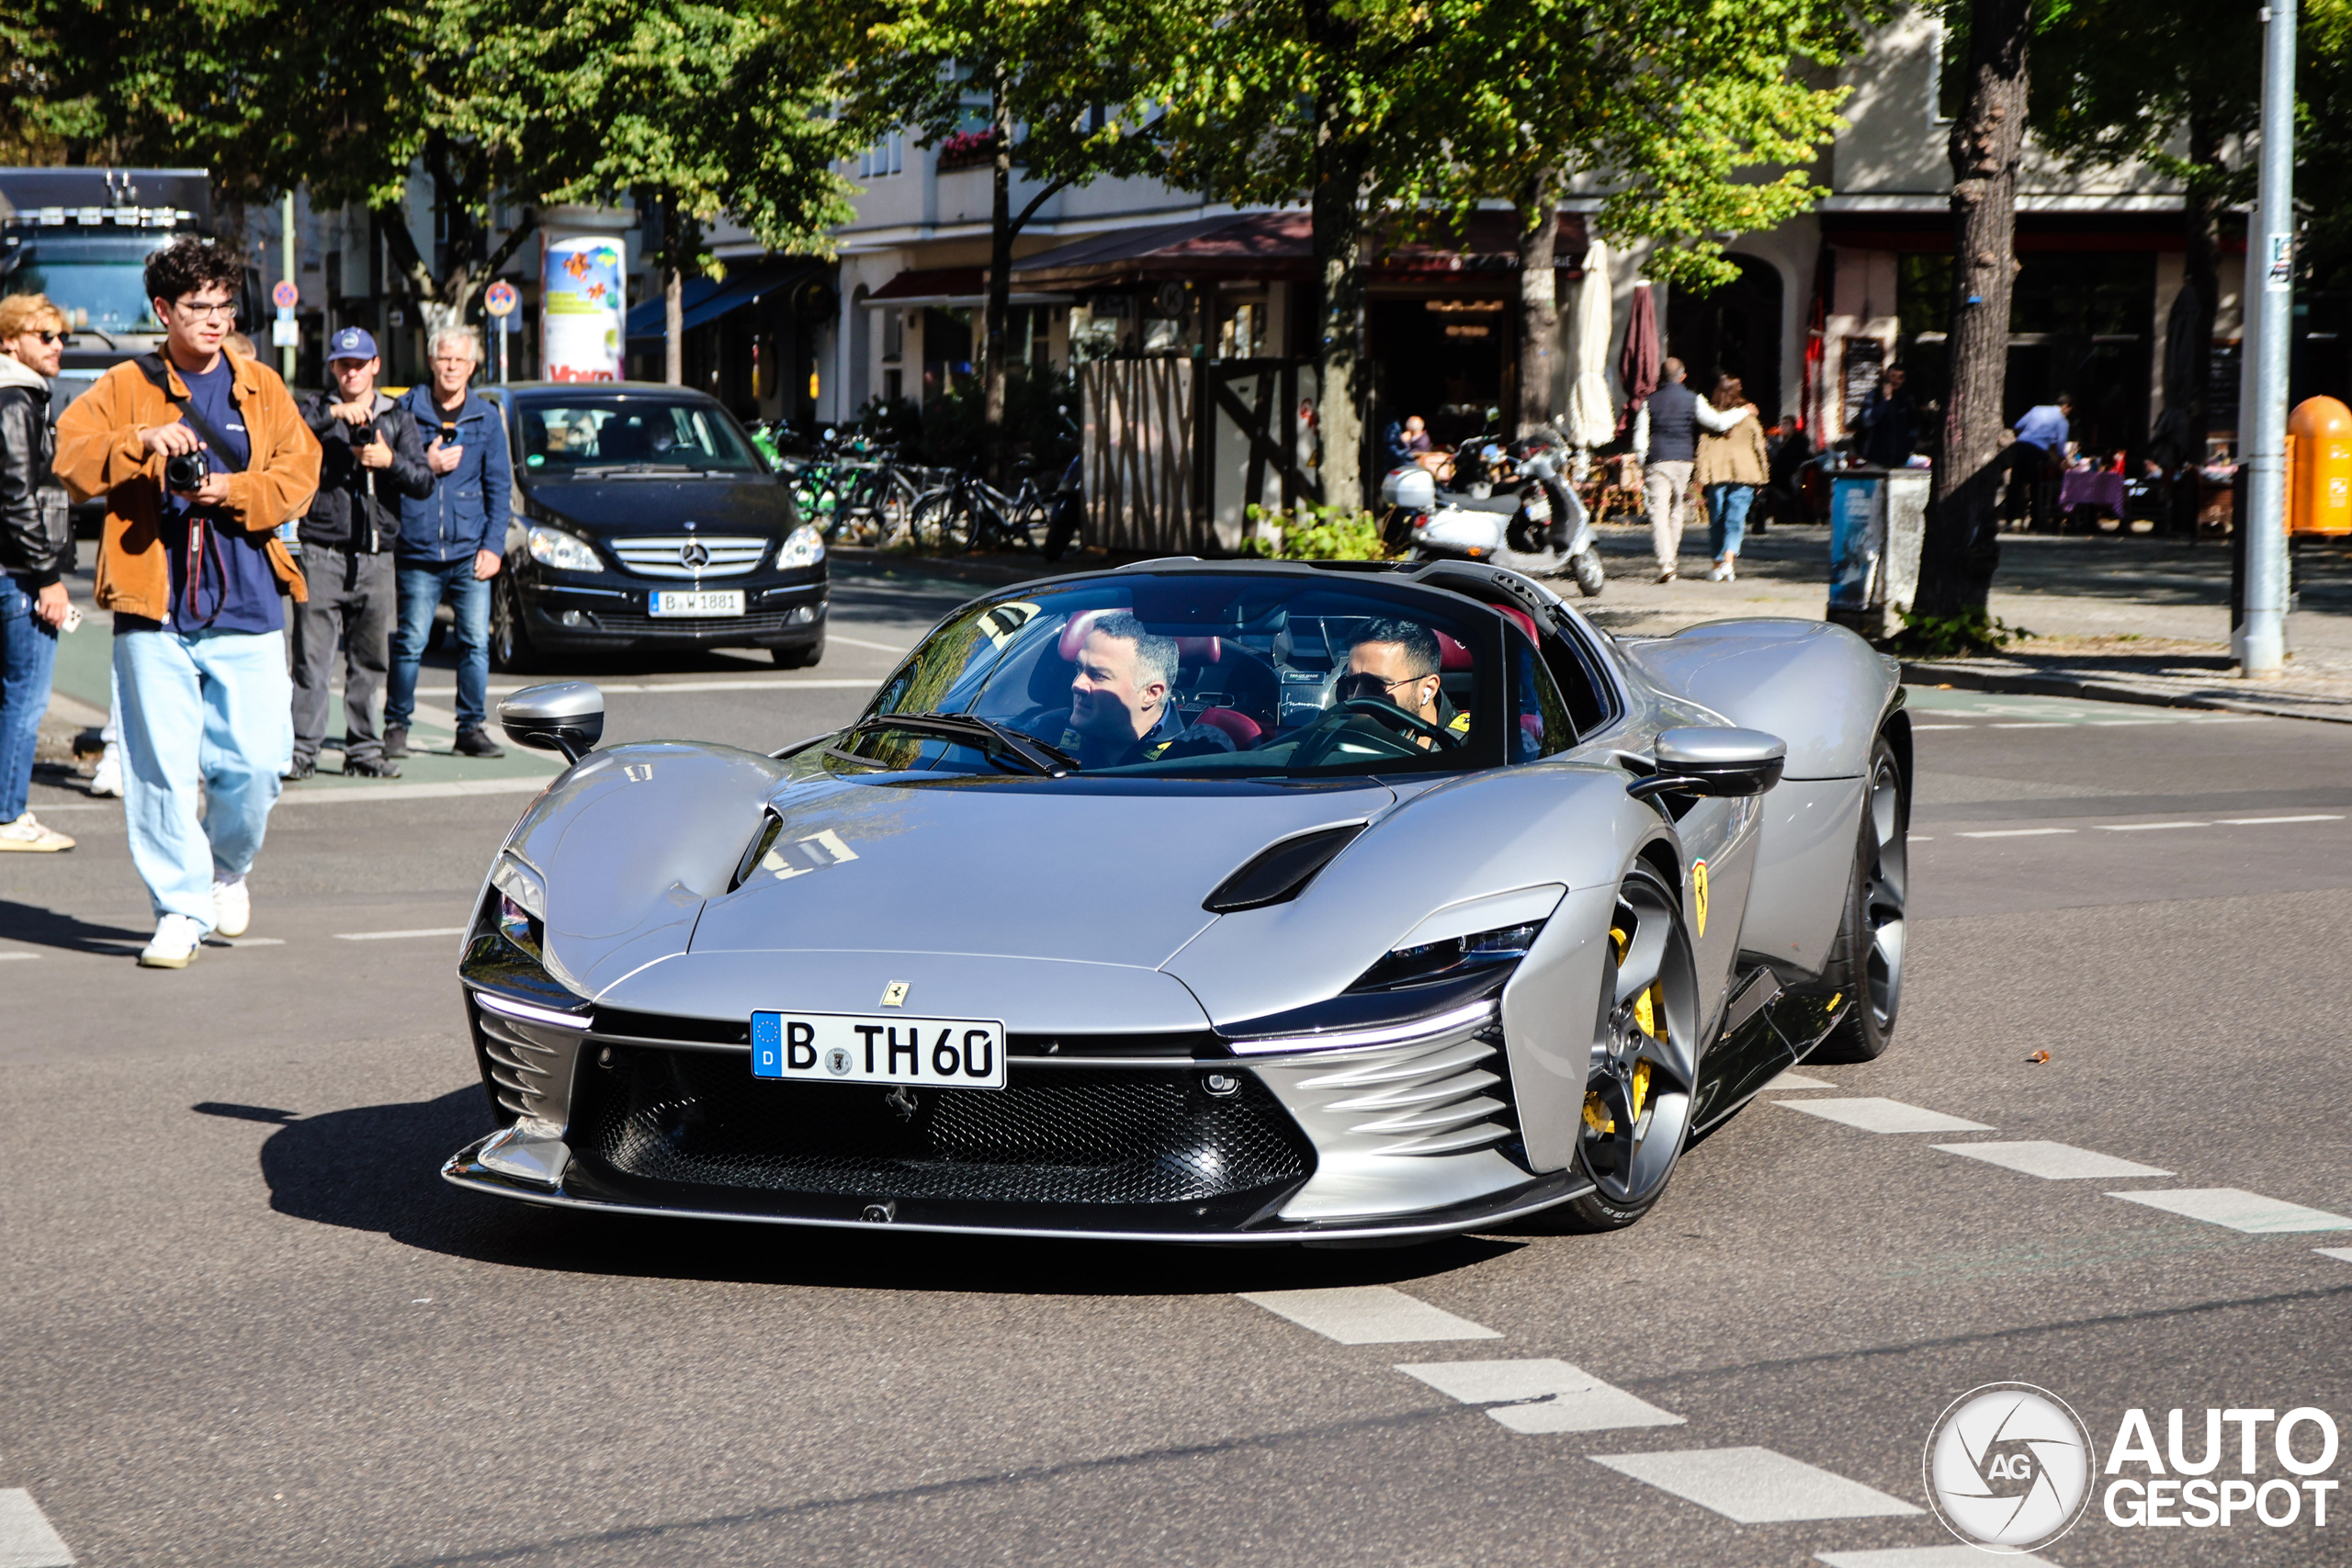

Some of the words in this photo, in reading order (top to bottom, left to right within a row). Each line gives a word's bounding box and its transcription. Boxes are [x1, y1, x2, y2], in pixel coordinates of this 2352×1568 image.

[666, 595, 675, 610] B
[686, 594, 695, 610] W
[700, 594, 735, 609] 1881
[787, 1021, 817, 1069] B
[854, 1025, 919, 1076] TH
[933, 1028, 993, 1077] 60
[763, 1051, 774, 1065] D
[1602, 1207, 1615, 1215] 20
